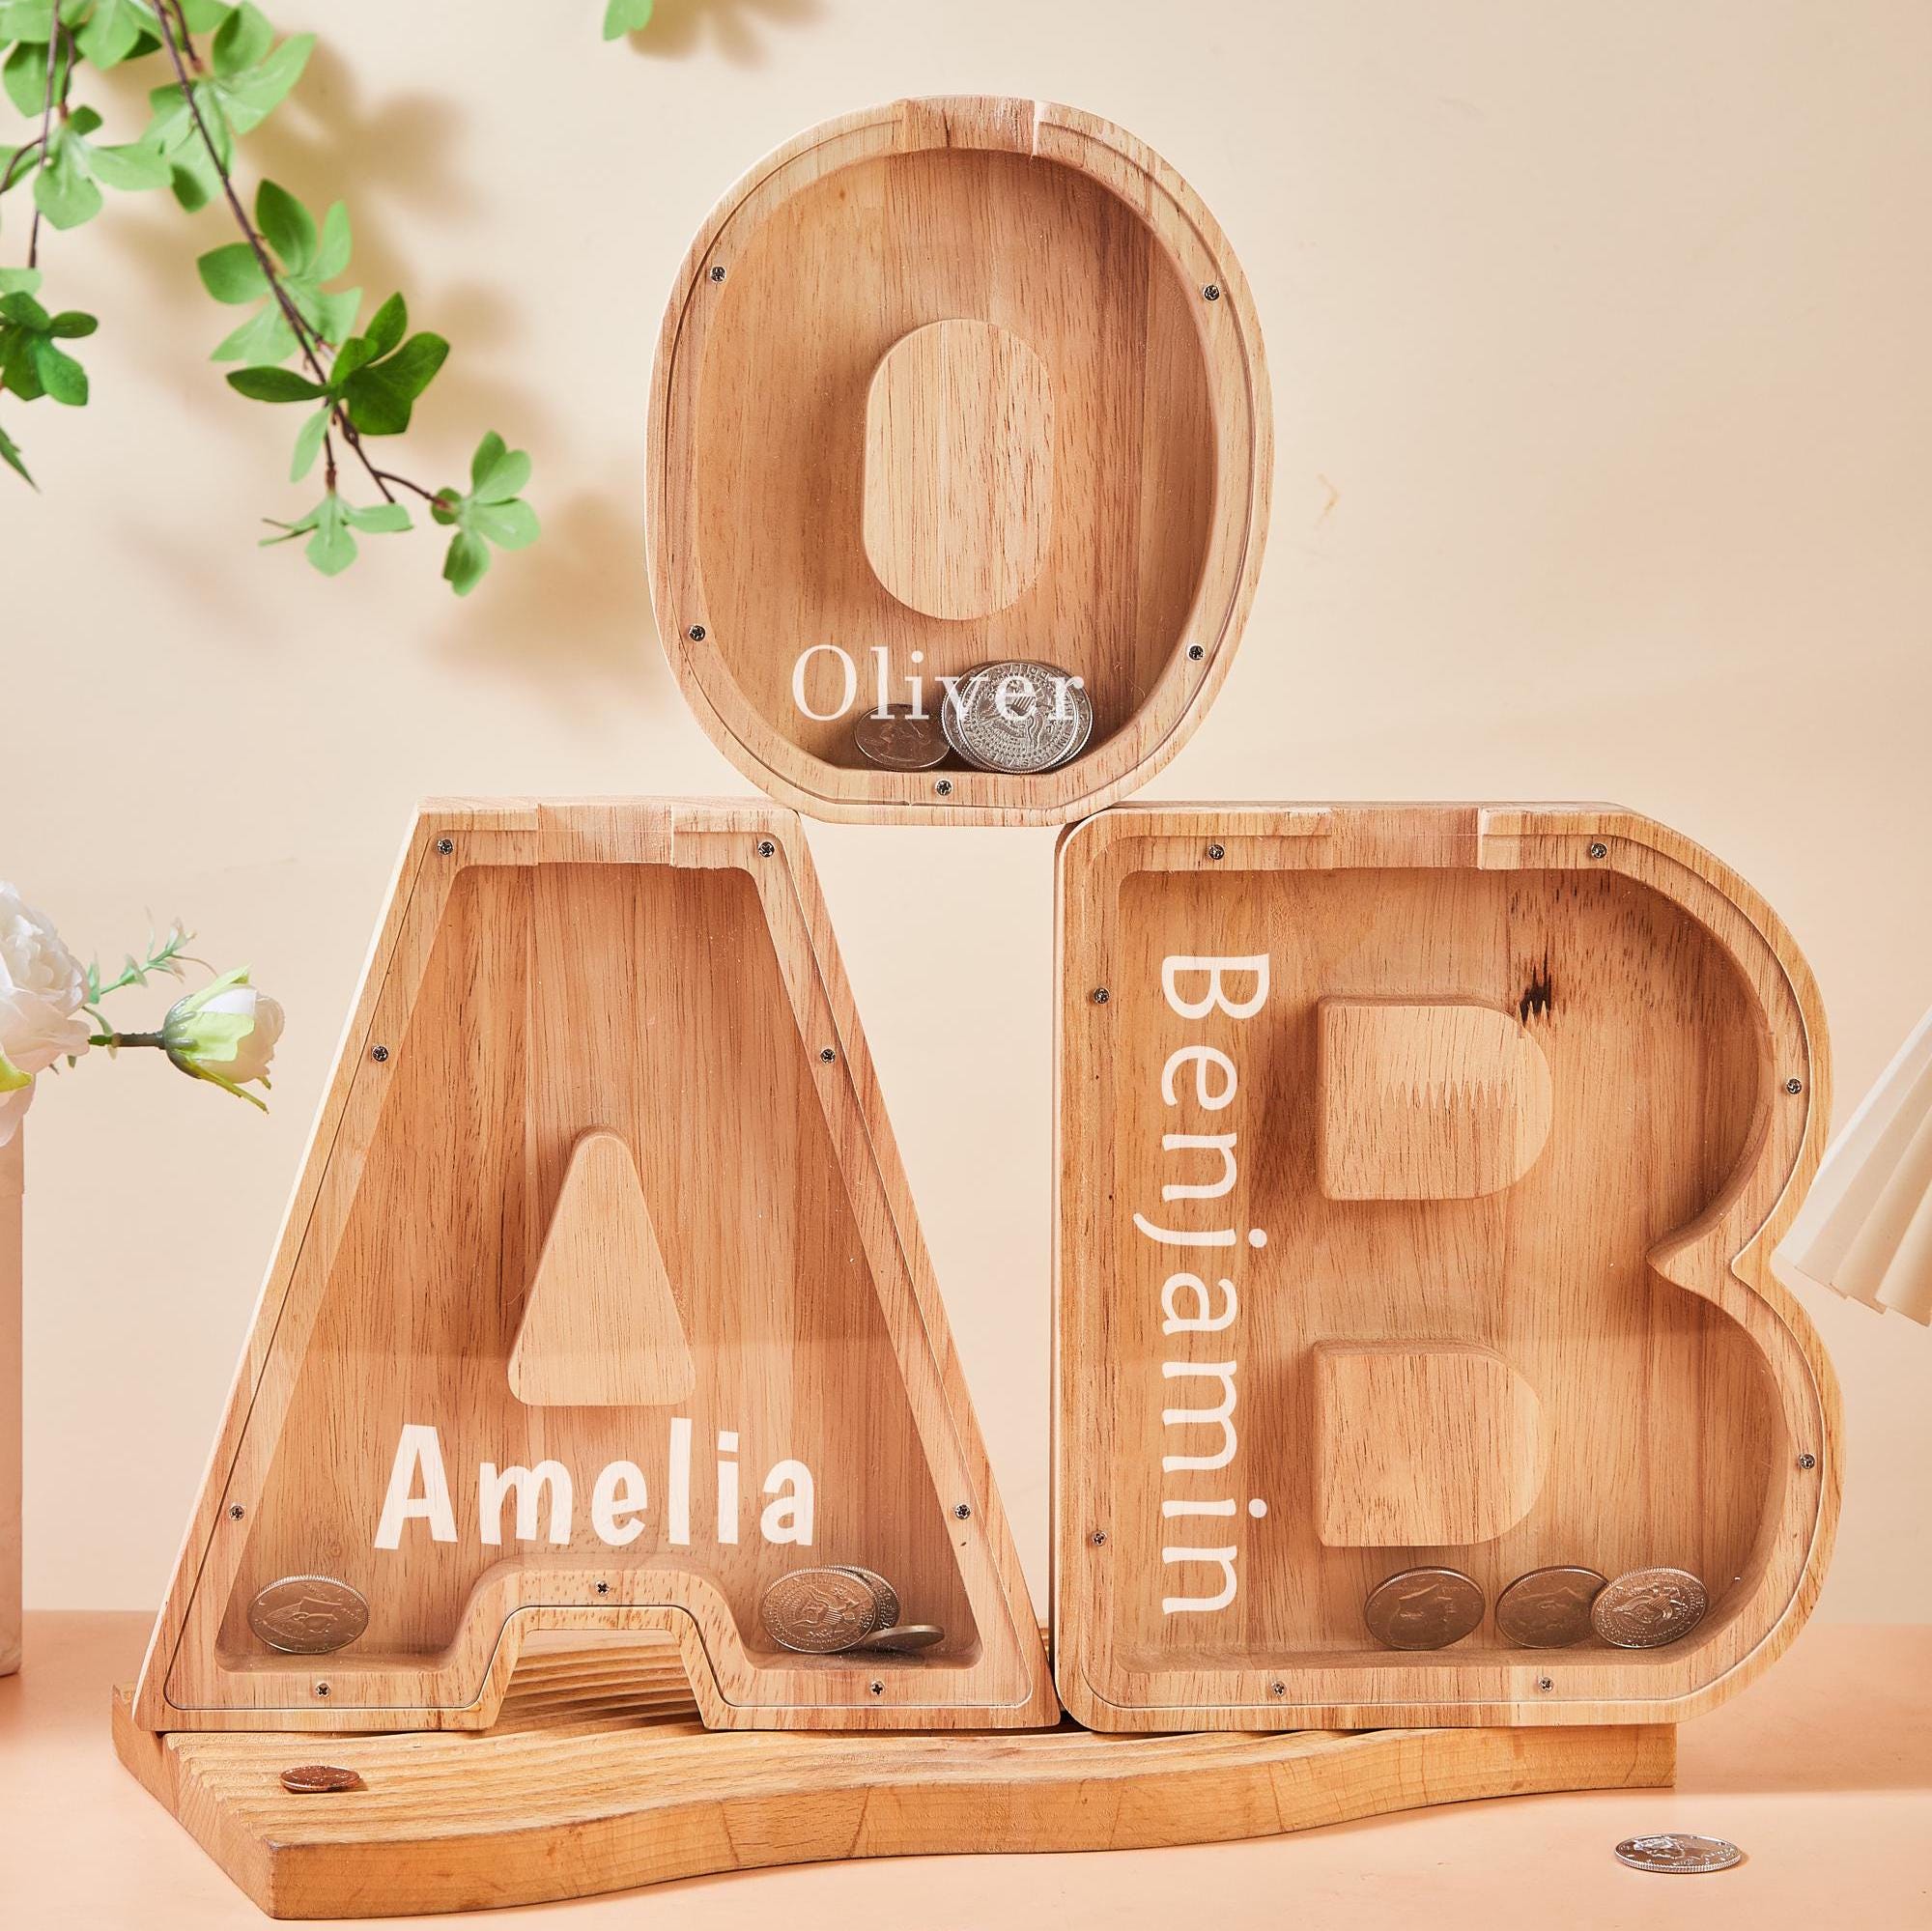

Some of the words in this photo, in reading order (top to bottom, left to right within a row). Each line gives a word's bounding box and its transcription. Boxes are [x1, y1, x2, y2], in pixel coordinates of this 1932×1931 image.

[791, 644, 1085, 722] Oliver
[1133, 954, 1270, 1615] Benjamin
[374, 1417, 814, 1550] Amelia
